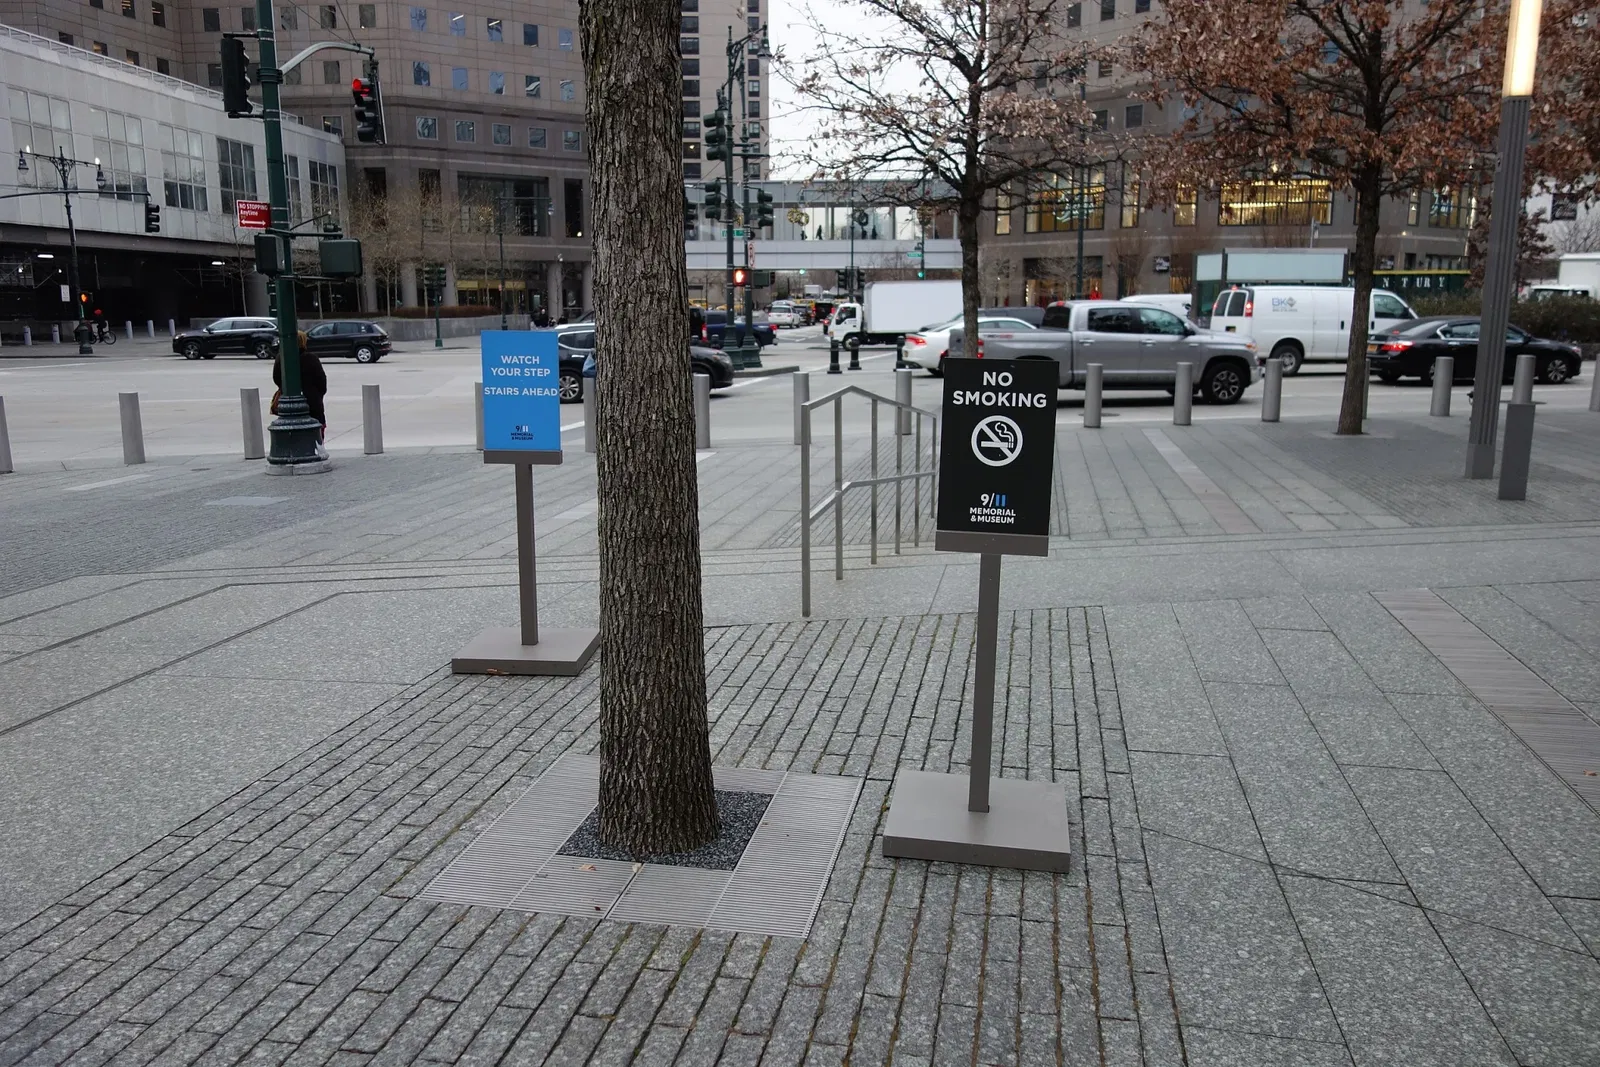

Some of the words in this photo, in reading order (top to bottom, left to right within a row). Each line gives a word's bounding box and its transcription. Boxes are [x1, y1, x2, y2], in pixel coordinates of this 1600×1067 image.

[501, 356, 540, 365] WATCH
[491, 368, 521, 376] YOUR
[524, 369, 550, 377] STEP
[982, 371, 1013, 386] NO
[484, 387, 519, 395] STAIRS
[522, 388, 558, 396] AHEAD
[952, 390, 1047, 408] SMOKING
[980, 492, 1006, 508] 9/11
[969, 507, 1016, 517] MEMORIAL
